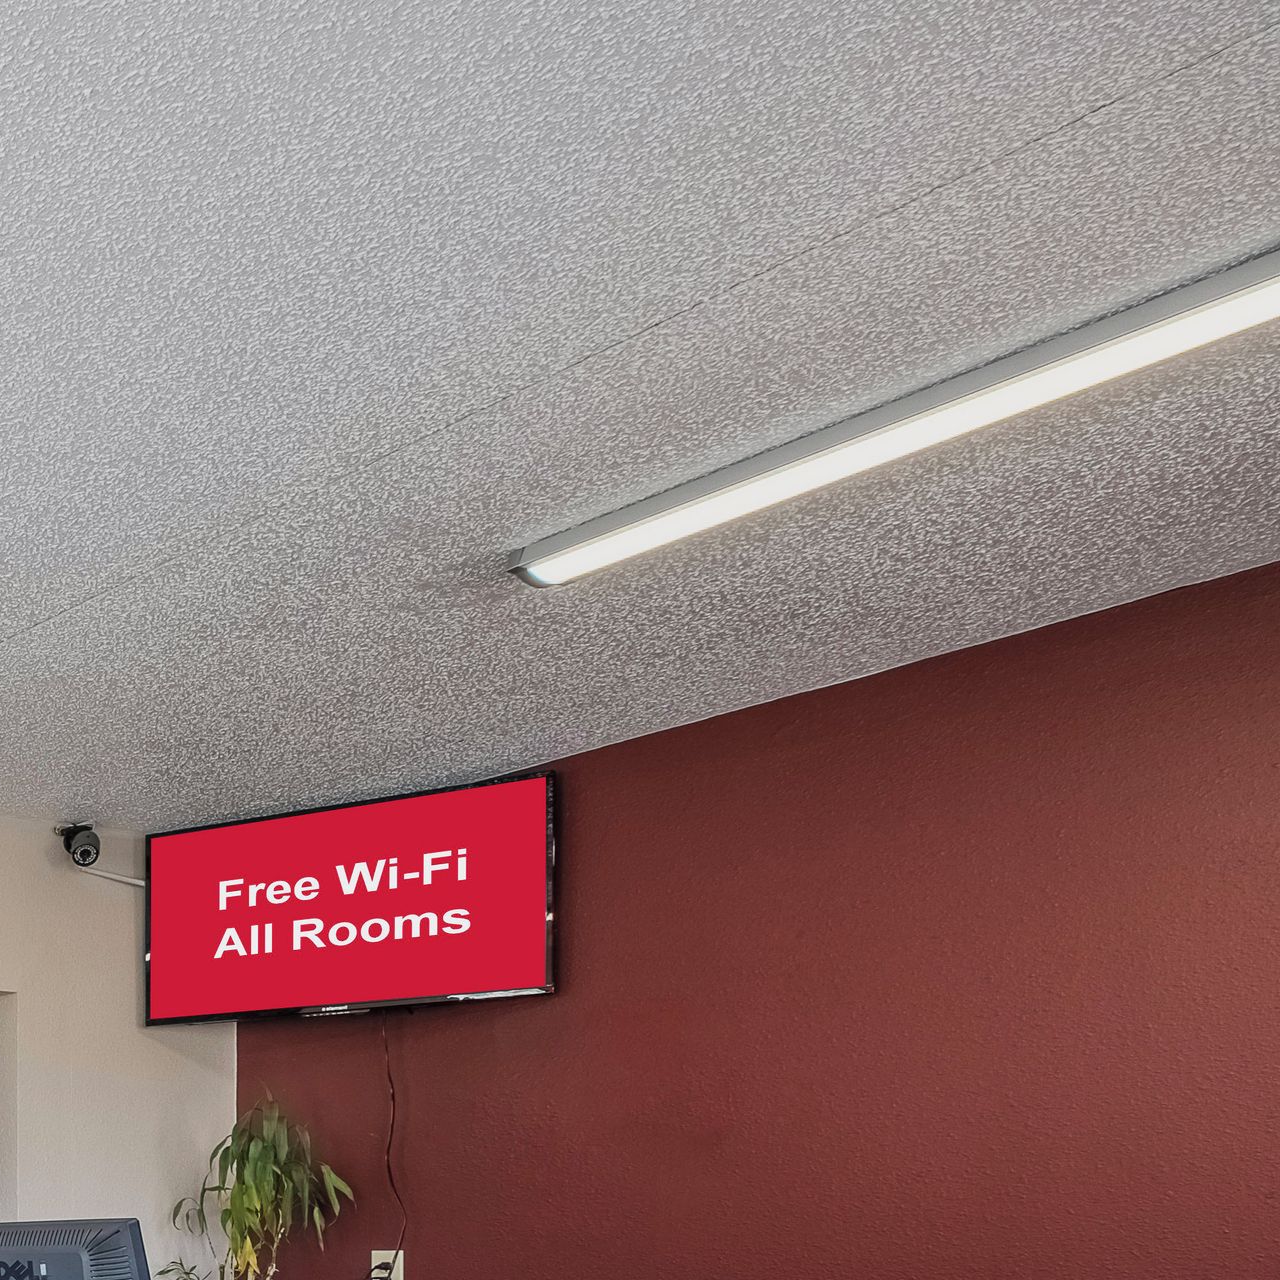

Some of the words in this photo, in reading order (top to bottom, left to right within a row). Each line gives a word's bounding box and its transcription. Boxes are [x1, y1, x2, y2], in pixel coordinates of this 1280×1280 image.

[219, 877, 319, 910] Free
[336, 848, 467, 895] Wi-Fi
[214, 923, 273, 959] All
[293, 908, 471, 950] Rooms
